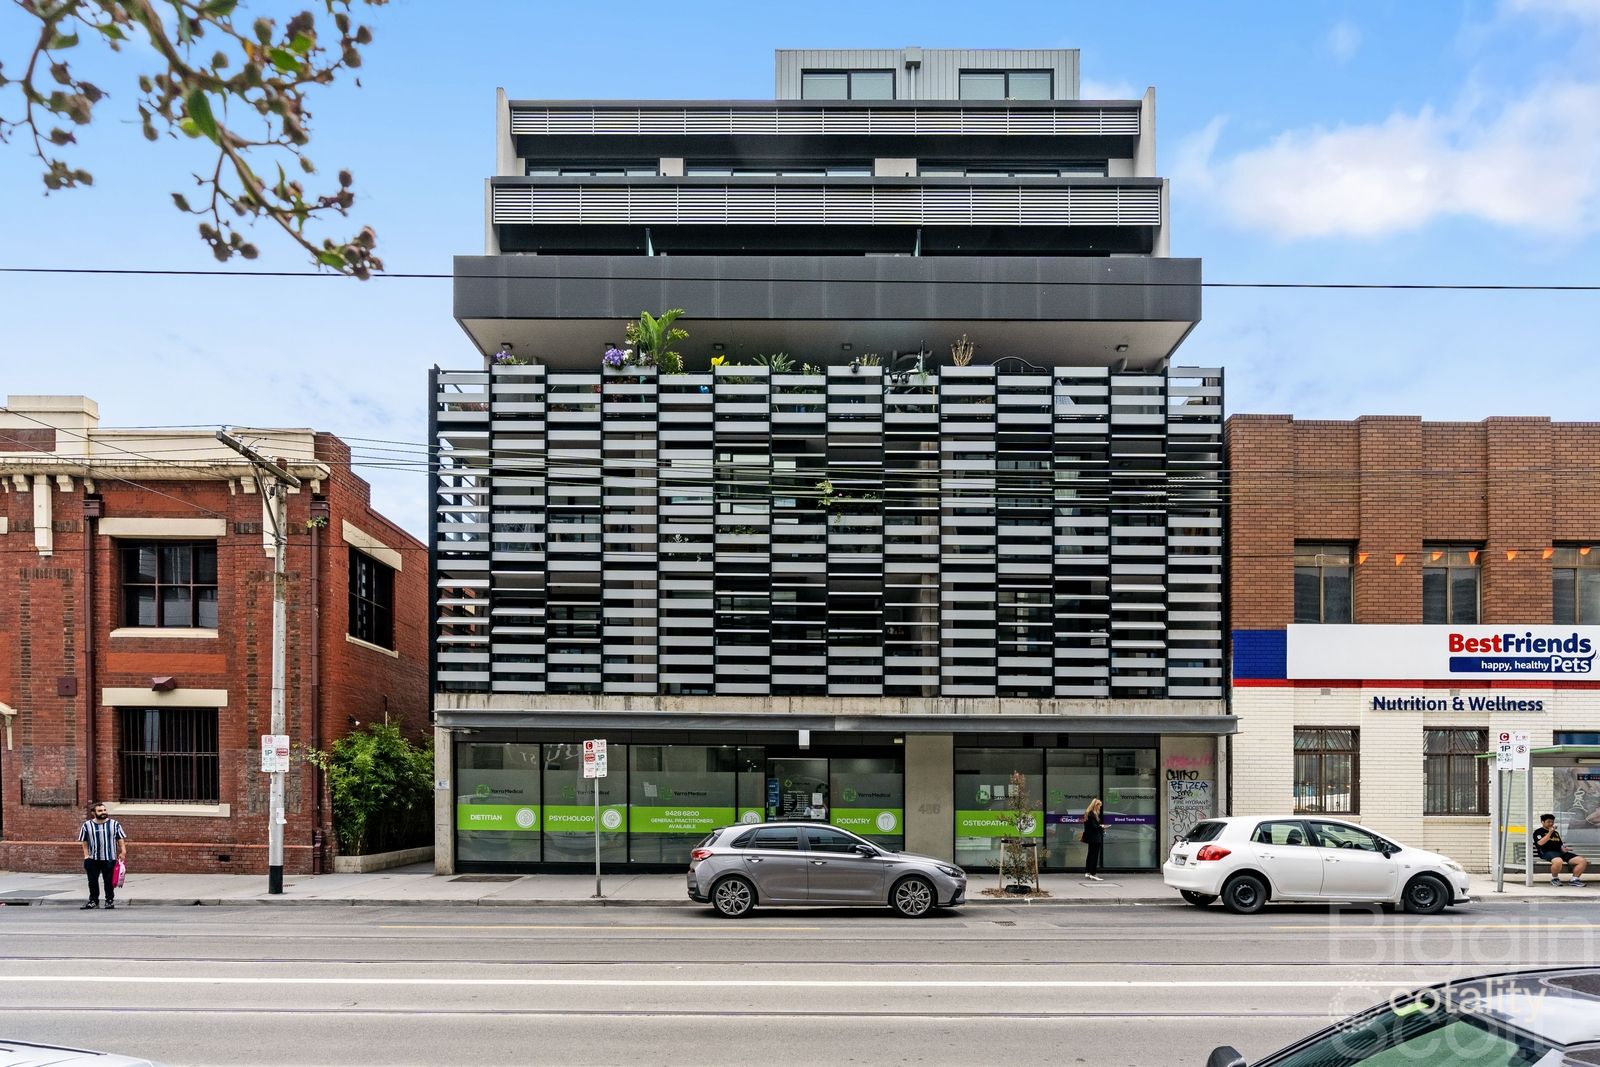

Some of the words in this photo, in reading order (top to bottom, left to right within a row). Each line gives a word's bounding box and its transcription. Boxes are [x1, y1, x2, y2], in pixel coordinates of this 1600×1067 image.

[1481, 660, 1512, 671] happy,
[1514, 660, 1549, 671] healthy
[1551, 656, 1590, 672] Pets
[1372, 696, 1447, 711] Nutrition
[1452, 696, 1464, 711] &
[1468, 696, 1543, 711] Wellness
[963, 819, 1008, 827] OSTEOPATHY
